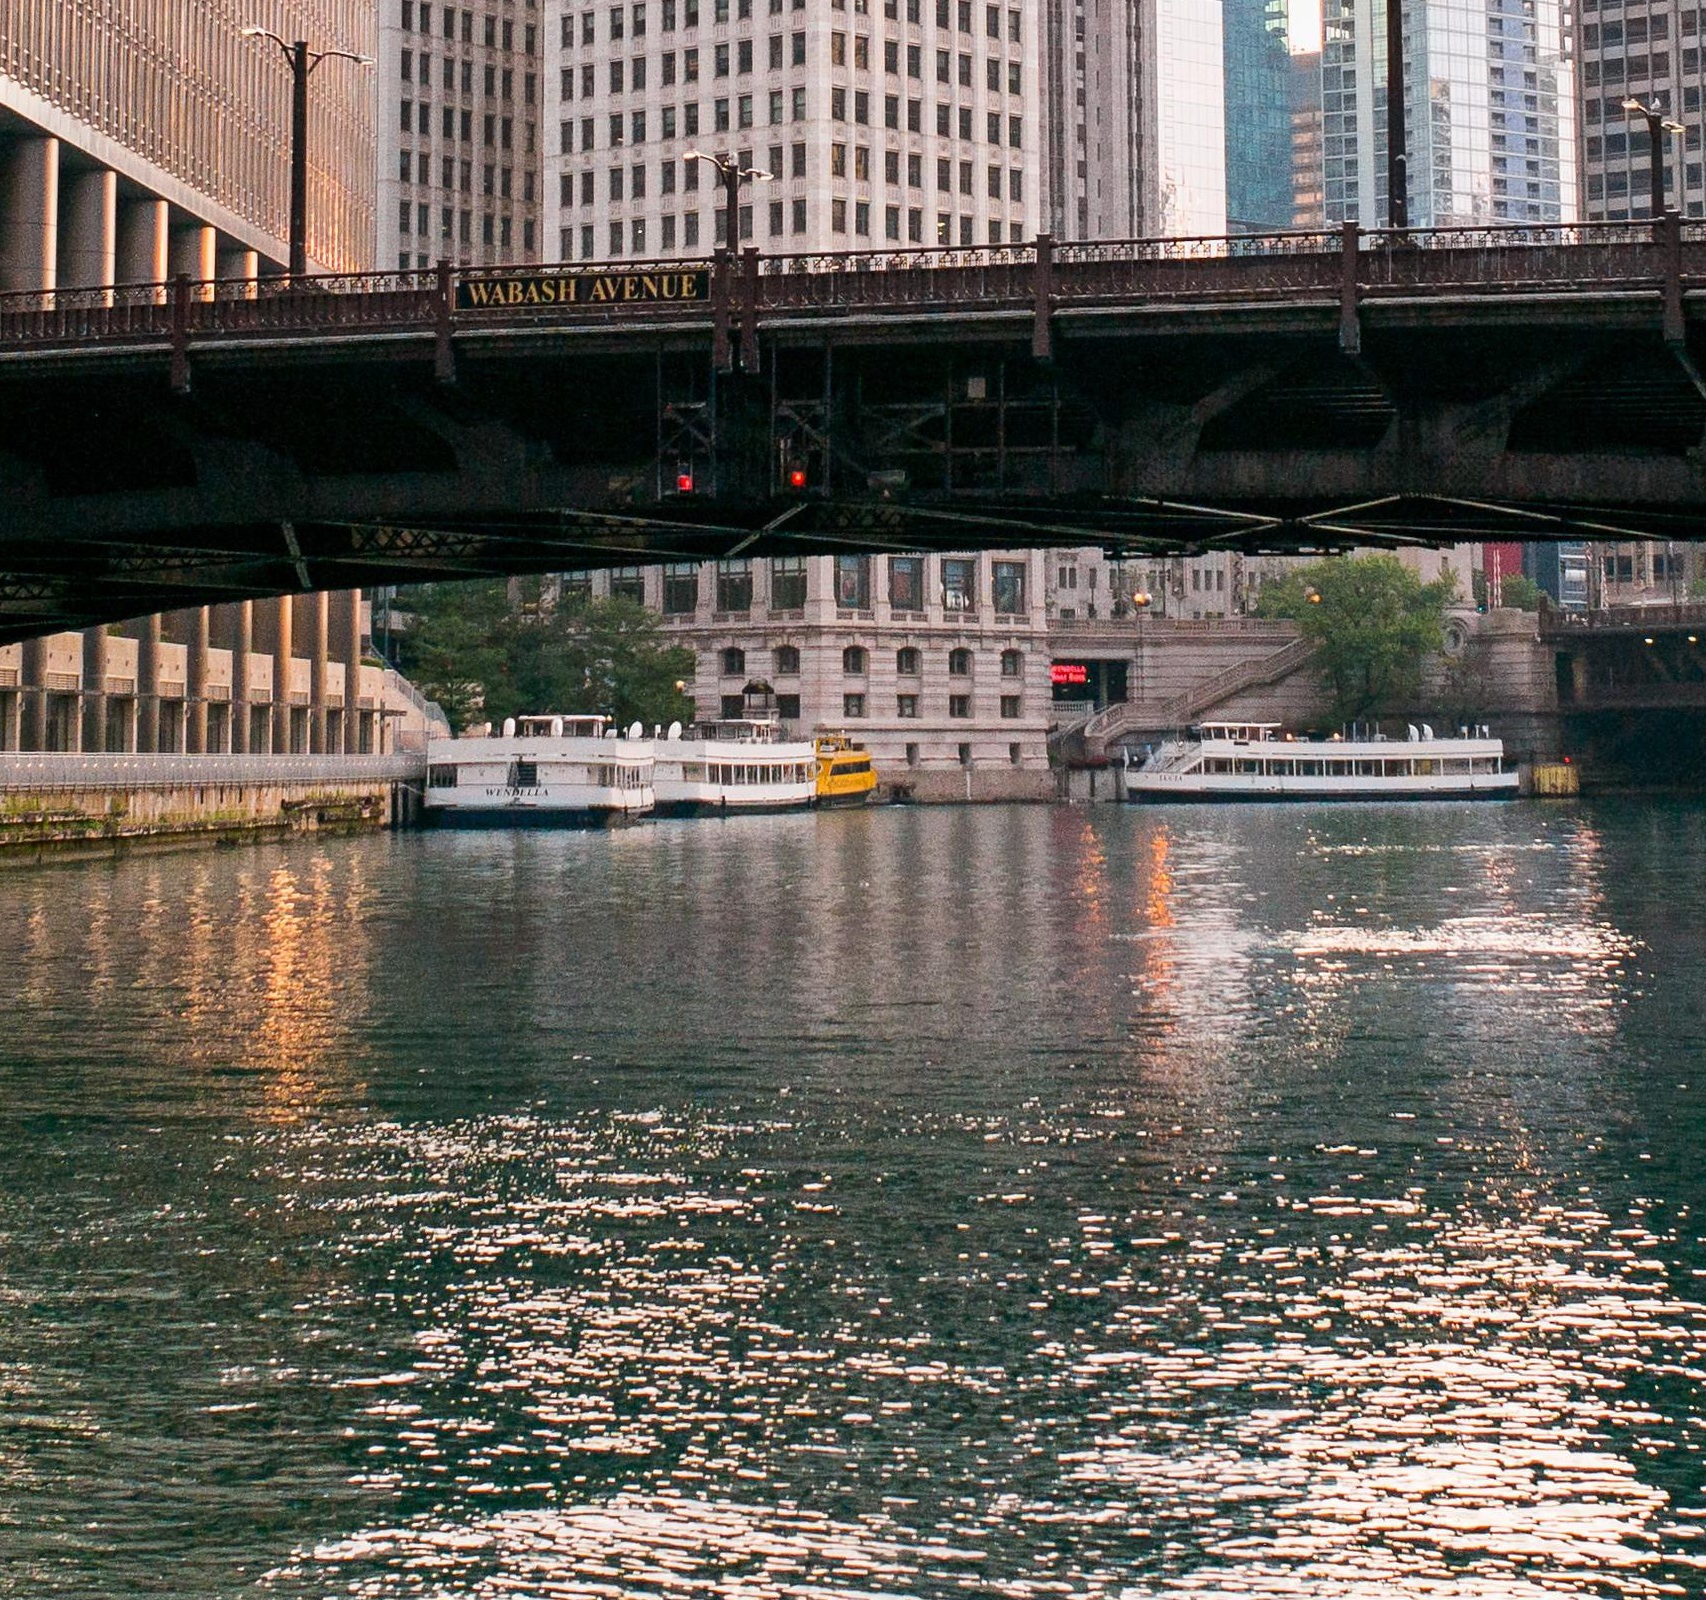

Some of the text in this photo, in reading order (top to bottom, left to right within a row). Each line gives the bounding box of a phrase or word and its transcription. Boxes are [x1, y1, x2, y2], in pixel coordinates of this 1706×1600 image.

[469, 273, 698, 306] WABASH AVENUE
[485, 787, 549, 797] WENDELLA
